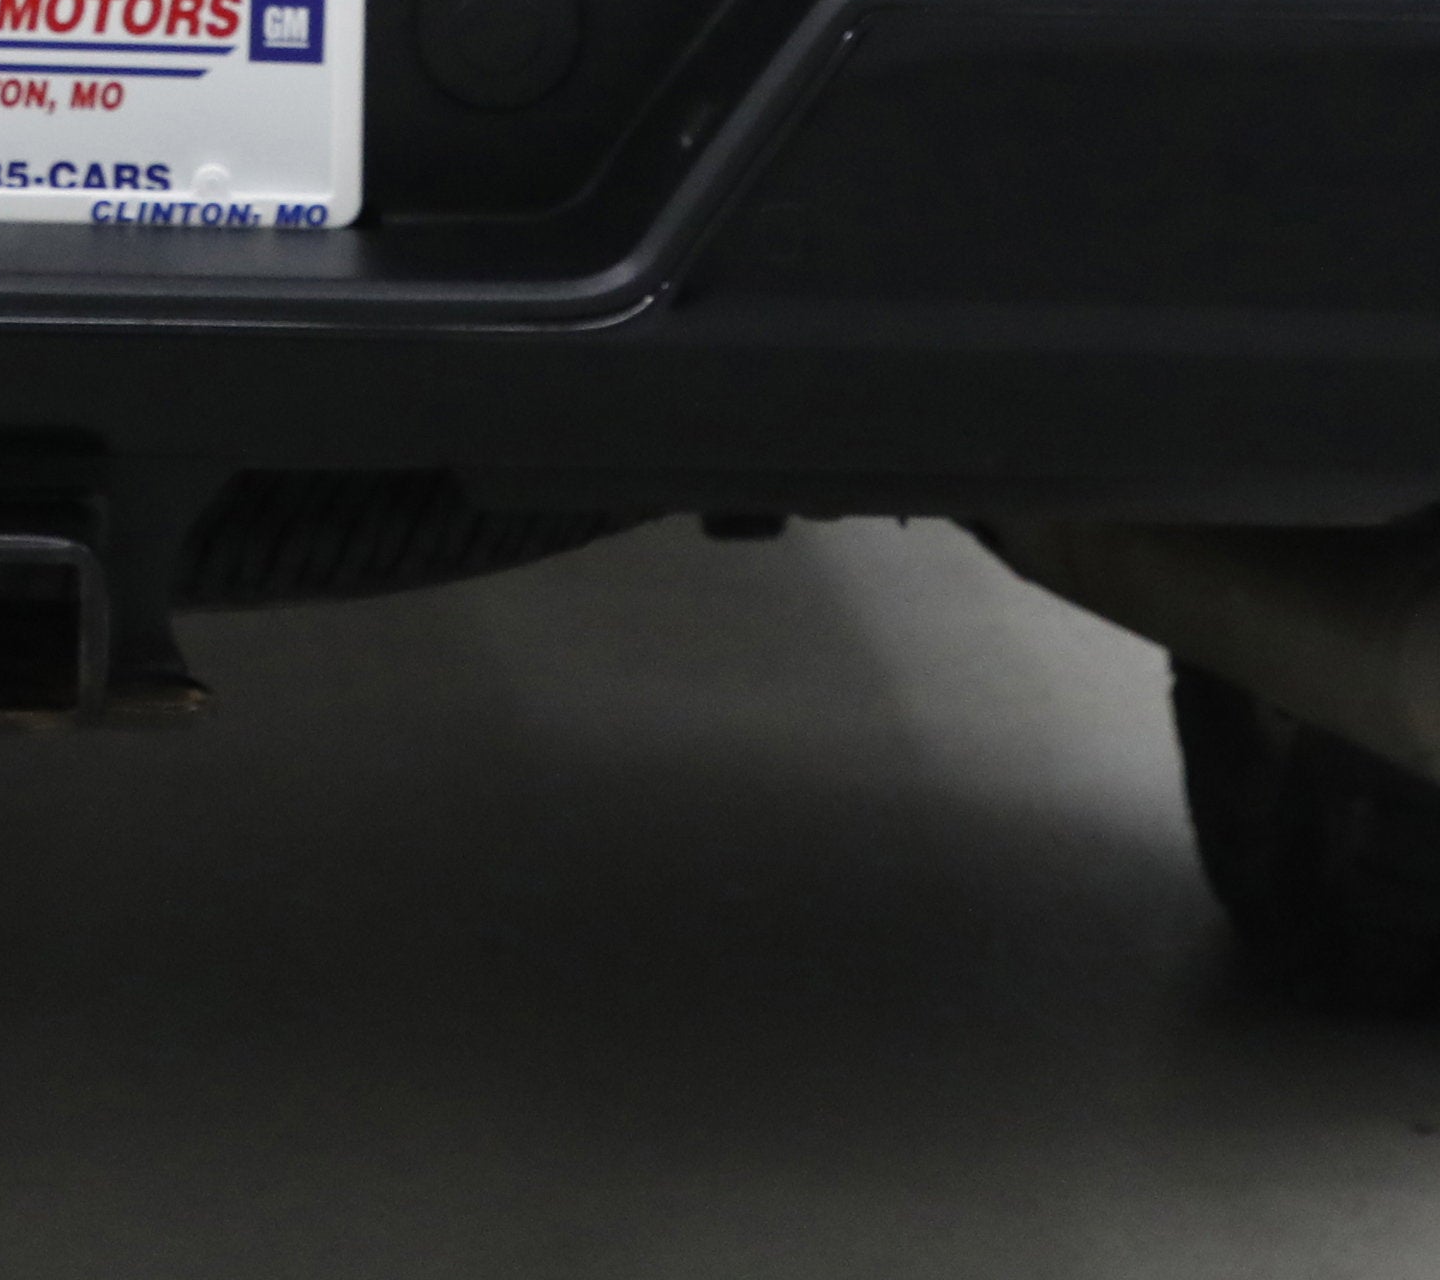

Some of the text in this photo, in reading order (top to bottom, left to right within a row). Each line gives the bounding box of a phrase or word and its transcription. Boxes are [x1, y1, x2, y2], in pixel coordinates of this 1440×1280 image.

[262, 5, 311, 48] GM
[69, 80, 126, 111] MO
[274, 203, 329, 228] MO
